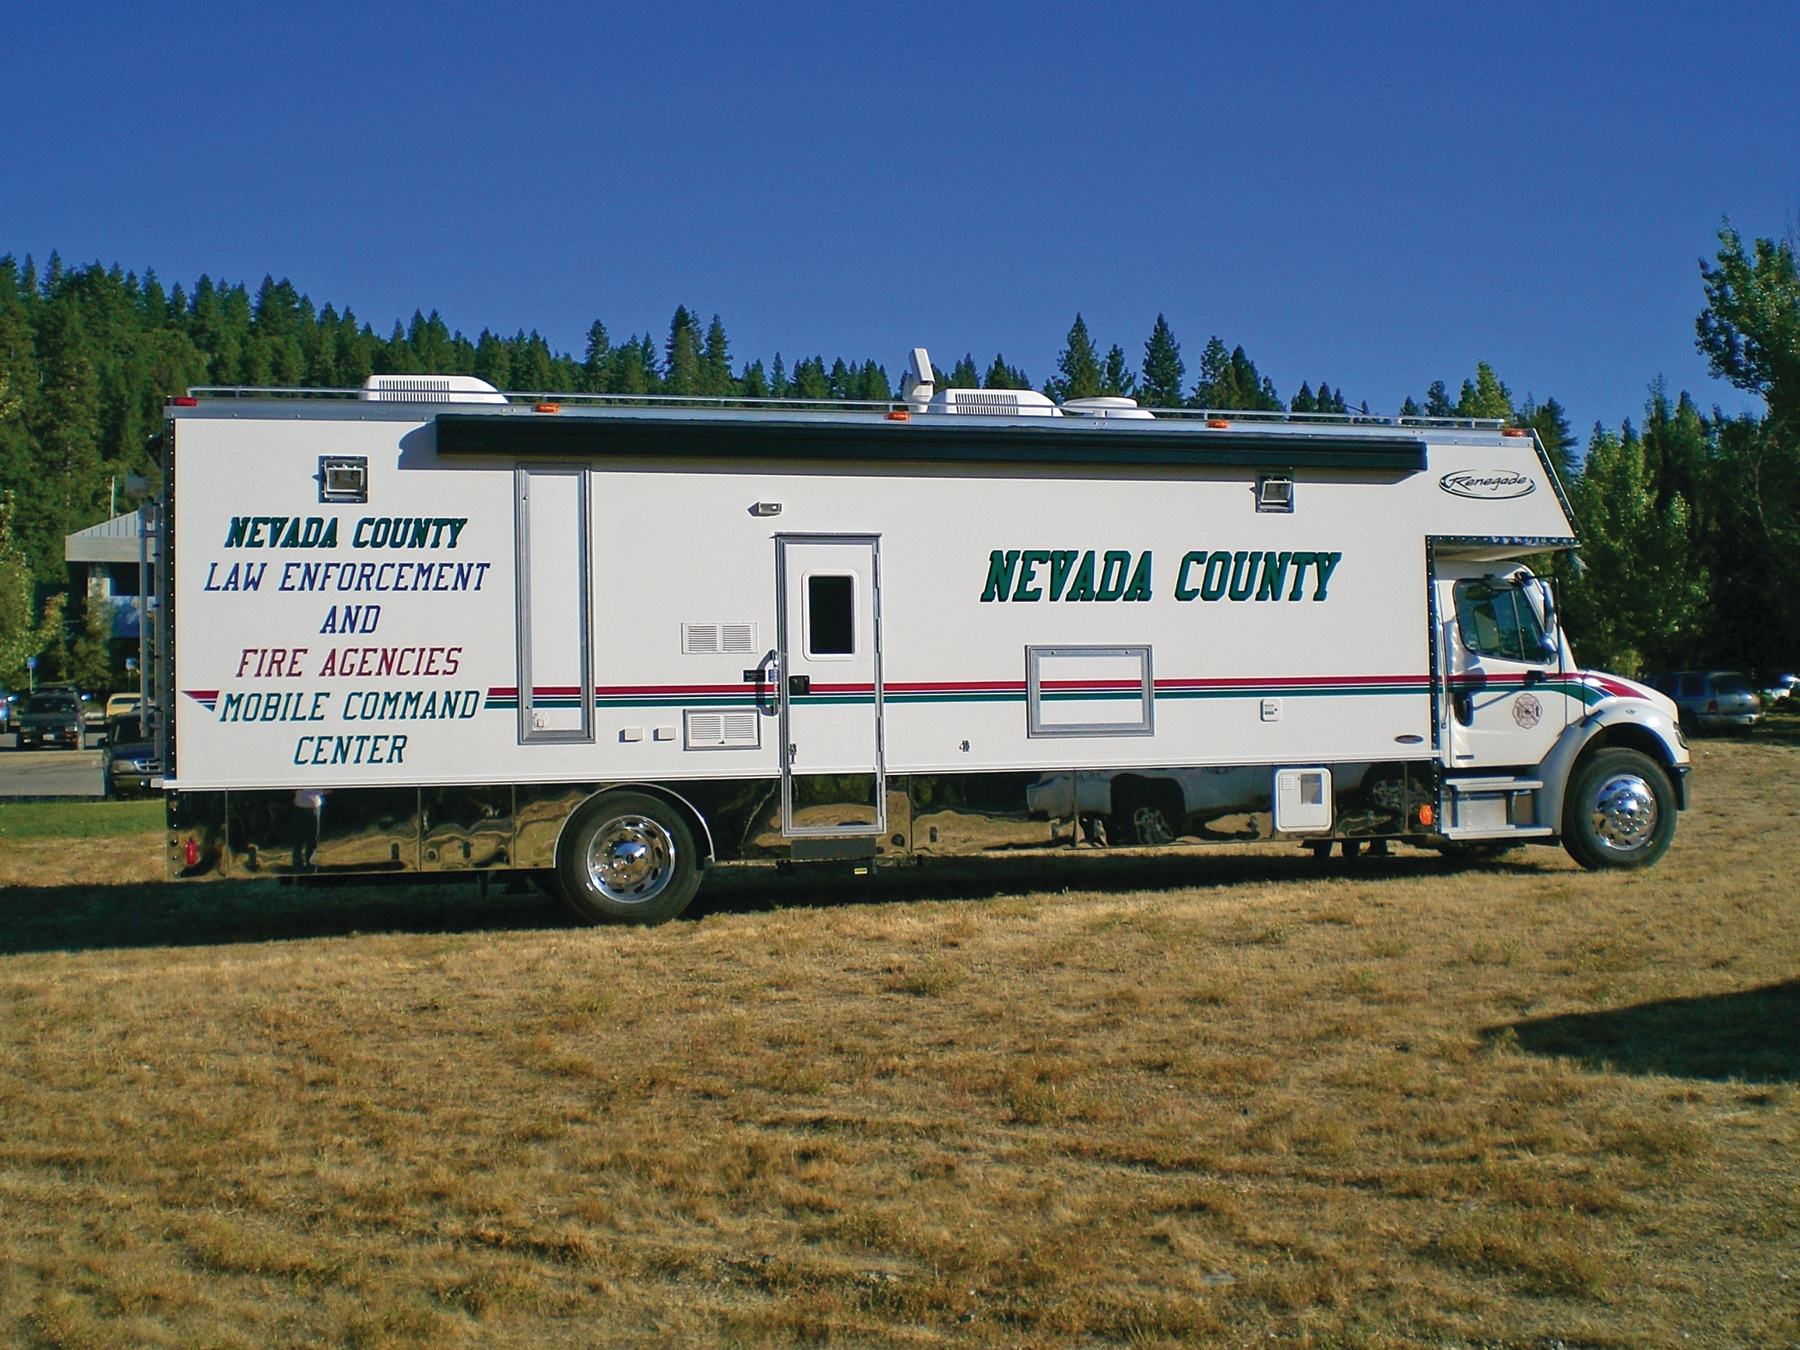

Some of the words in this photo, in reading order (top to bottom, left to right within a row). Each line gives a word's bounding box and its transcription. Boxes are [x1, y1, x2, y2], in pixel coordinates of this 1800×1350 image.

[1449, 473, 1527, 491] Renegade
[224, 517, 338, 548] NEVADA
[352, 518, 468, 548] COUNTY
[204, 562, 267, 592] LAW
[278, 562, 491, 592] ENFORCEMENT
[979, 550, 1153, 602] NEVADA
[1174, 551, 1342, 601] COUNTY
[319, 605, 381, 634] AND
[235, 648, 308, 678] FIRE
[318, 647, 462, 677] AGENCIES
[219, 692, 330, 722] MOBILE
[342, 690, 480, 720] COMMAND
[293, 735, 408, 765] CENTER
